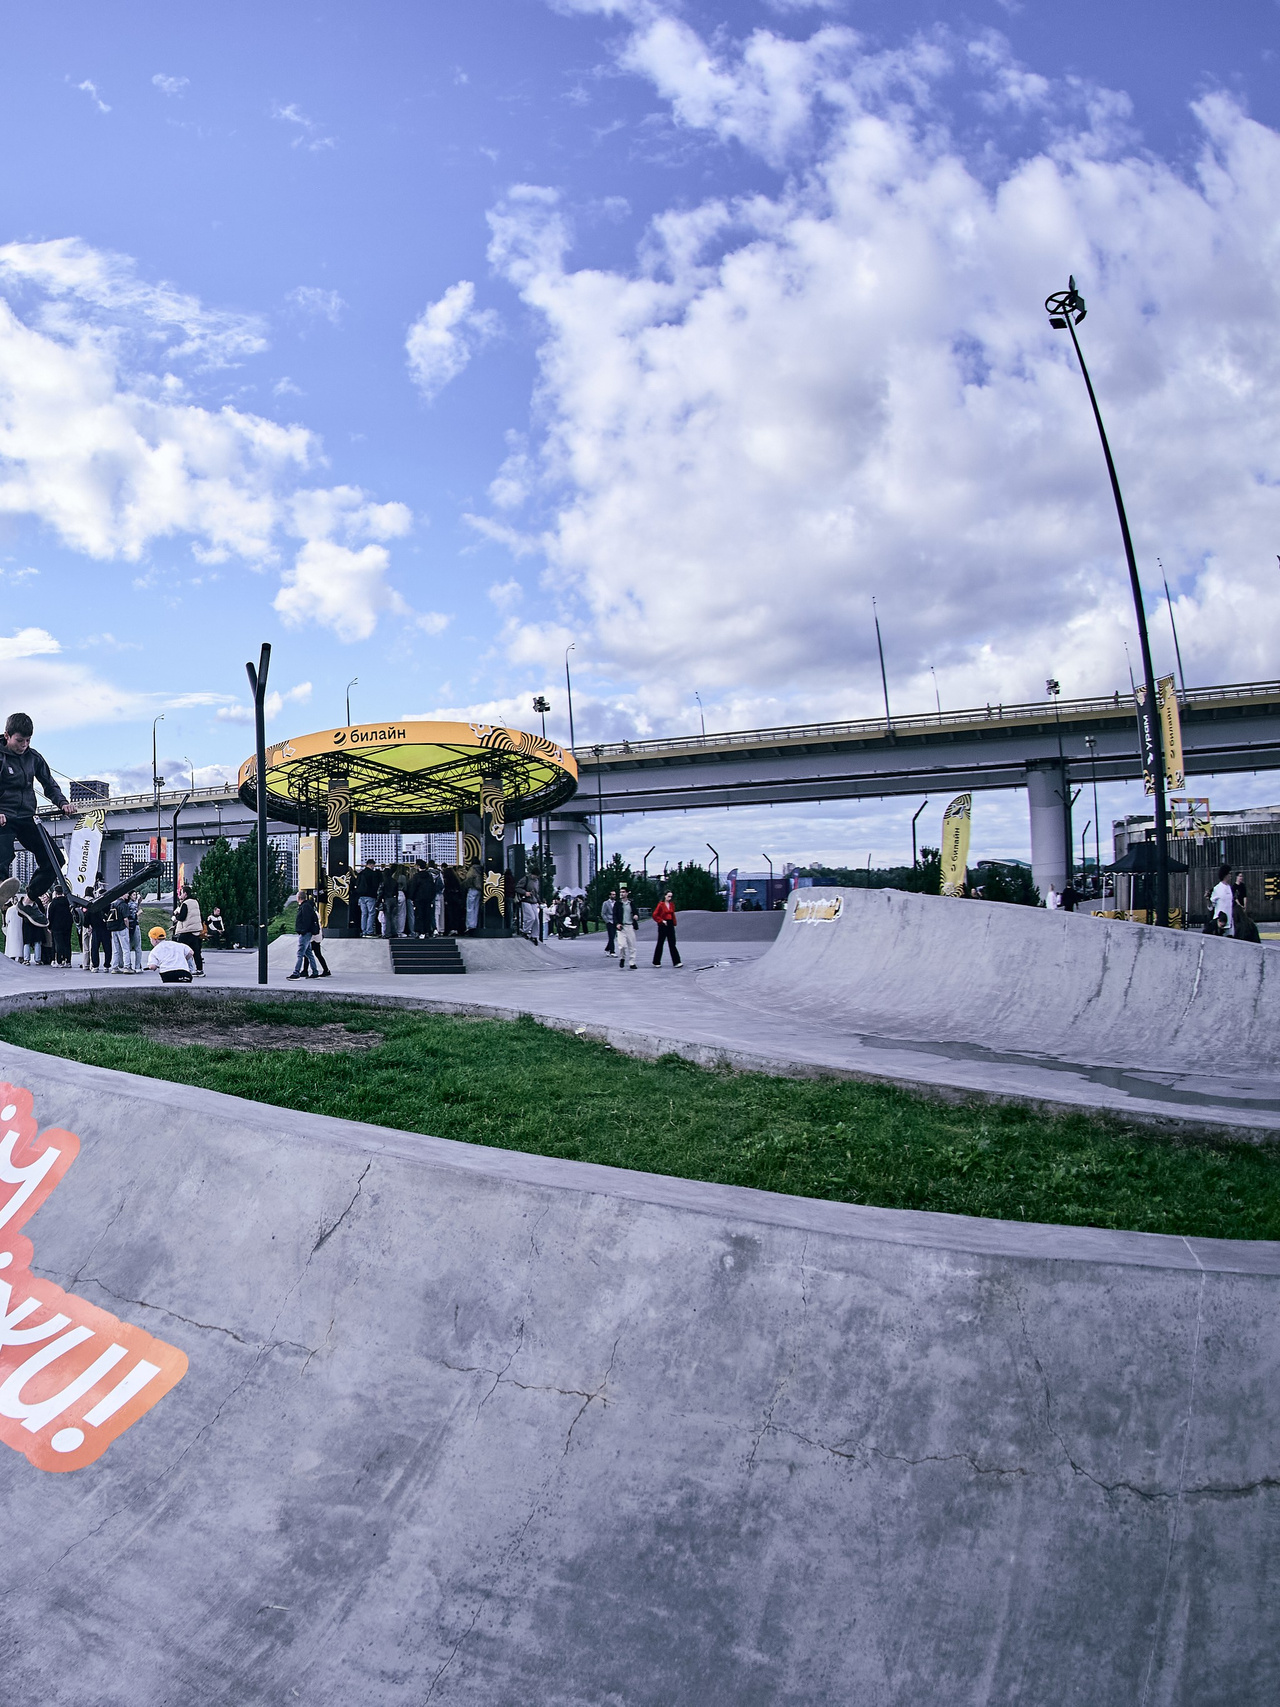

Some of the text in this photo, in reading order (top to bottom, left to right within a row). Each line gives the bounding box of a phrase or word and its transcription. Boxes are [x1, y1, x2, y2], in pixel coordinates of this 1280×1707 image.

[350, 726, 406, 743] билайн
[78, 839, 91, 873] билайн
[950, 827, 960, 863] билайн
